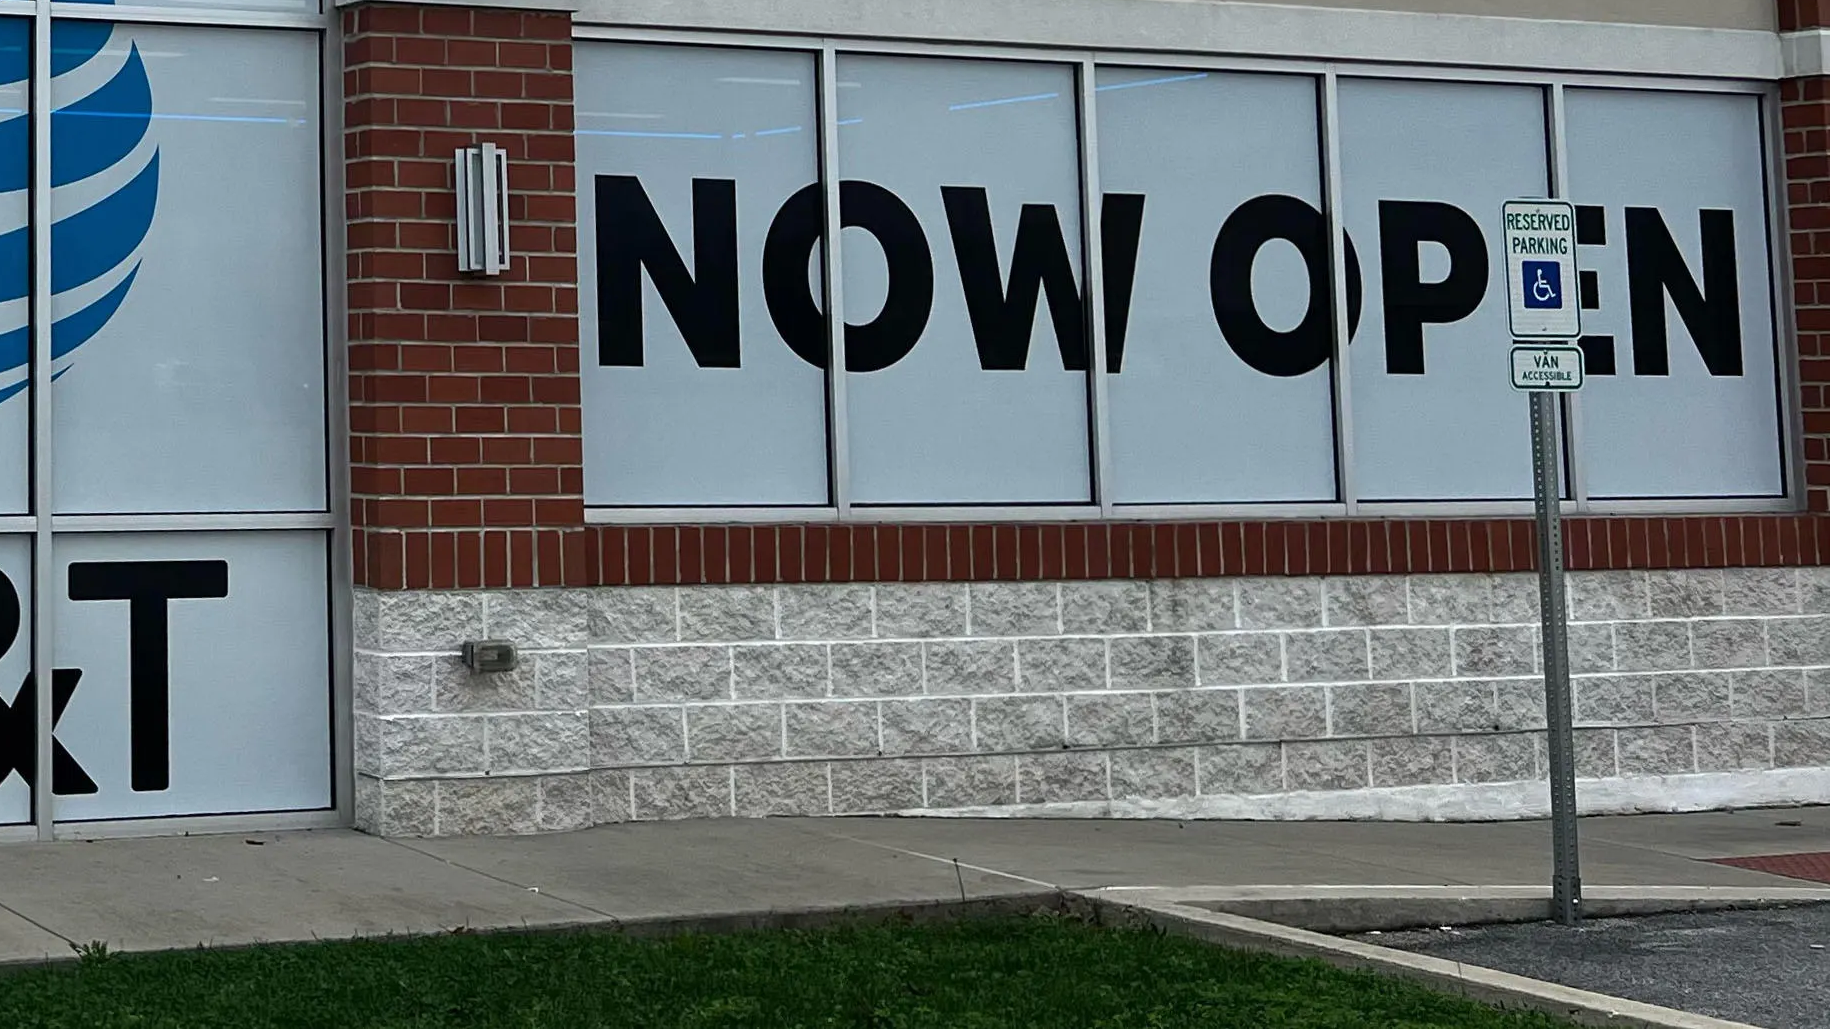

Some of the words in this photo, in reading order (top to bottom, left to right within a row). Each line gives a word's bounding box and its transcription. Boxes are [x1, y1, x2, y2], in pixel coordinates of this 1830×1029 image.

[1507, 213, 1570, 231] RESERVED
[1512, 237, 1568, 255] PARKING
[594, 175, 1146, 374] NOW
[1534, 355, 1559, 368] VAN
[1522, 371, 1572, 381] ACCESSIBLE
